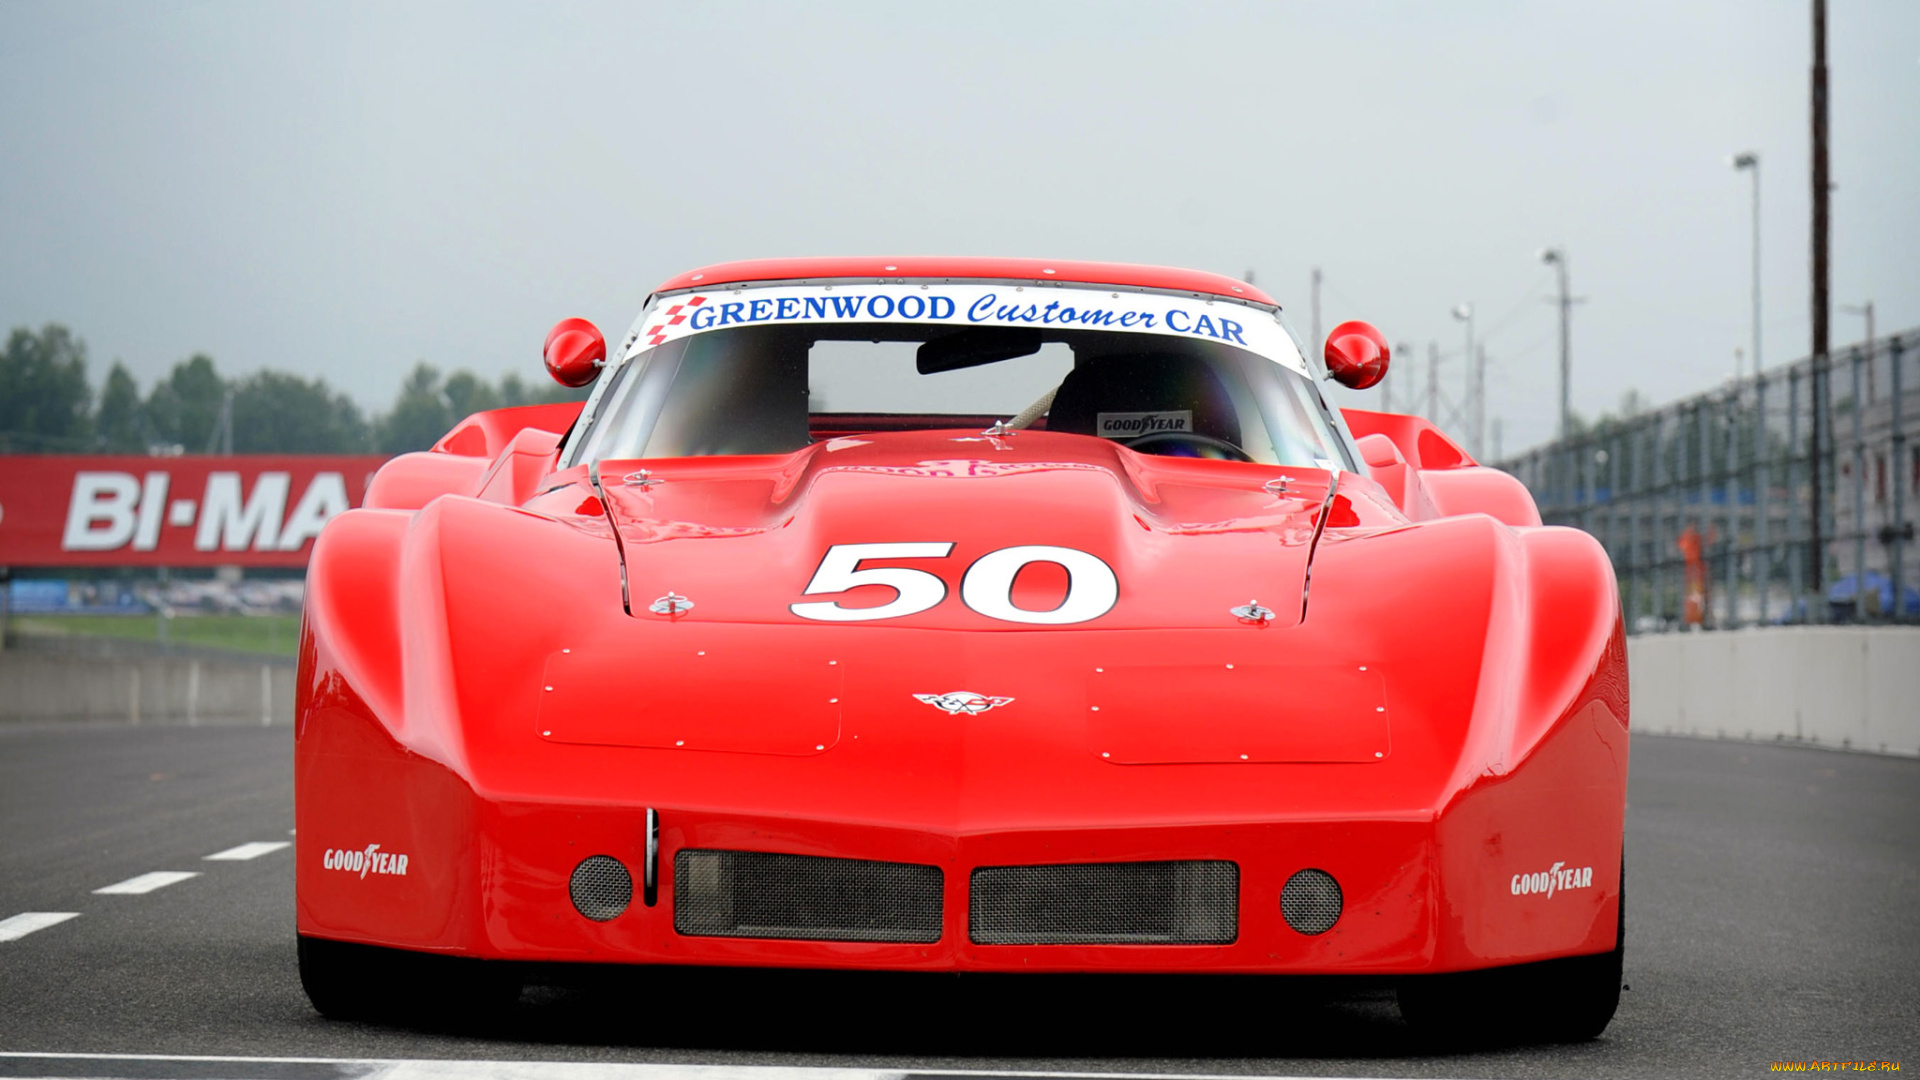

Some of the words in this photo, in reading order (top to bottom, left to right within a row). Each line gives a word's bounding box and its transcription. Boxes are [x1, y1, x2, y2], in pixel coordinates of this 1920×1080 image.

[690, 295, 955, 330] GREENWOOD
[967, 293, 1158, 328] Customer
[1165, 309, 1248, 346] CAR
[1103, 415, 1185, 434] GOODYEAR
[789, 541, 1120, 625] 50
[323, 844, 408, 880] GOODYEAR
[1510, 861, 1593, 899] GOODYEAR
